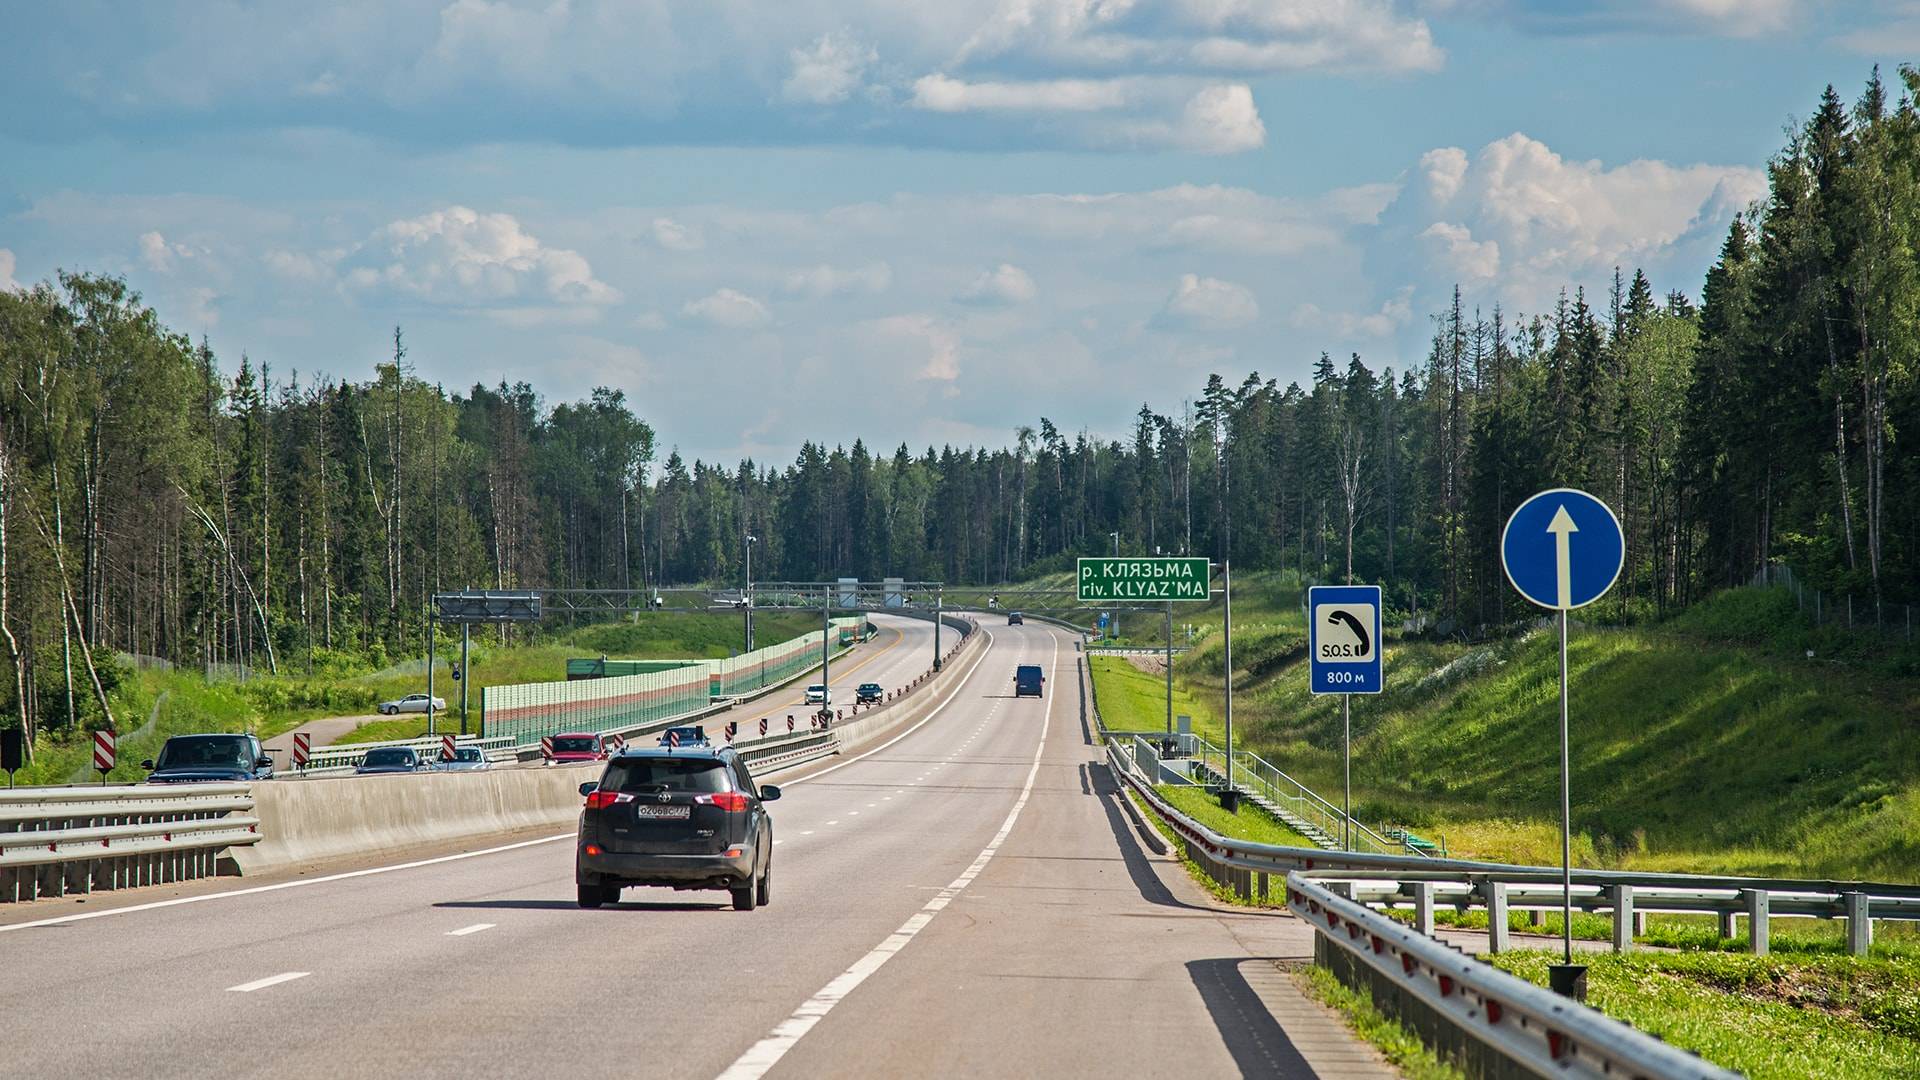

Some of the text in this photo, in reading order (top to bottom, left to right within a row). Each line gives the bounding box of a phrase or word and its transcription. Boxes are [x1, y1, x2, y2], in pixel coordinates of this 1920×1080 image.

[1082, 562, 1193, 580] р. КЛЯЗЬМА
[1082, 581, 1204, 596] riv. KLYAZ'MA
[1322, 644, 1353, 658] S.O.S.
[1327, 671, 1352, 683] 800
